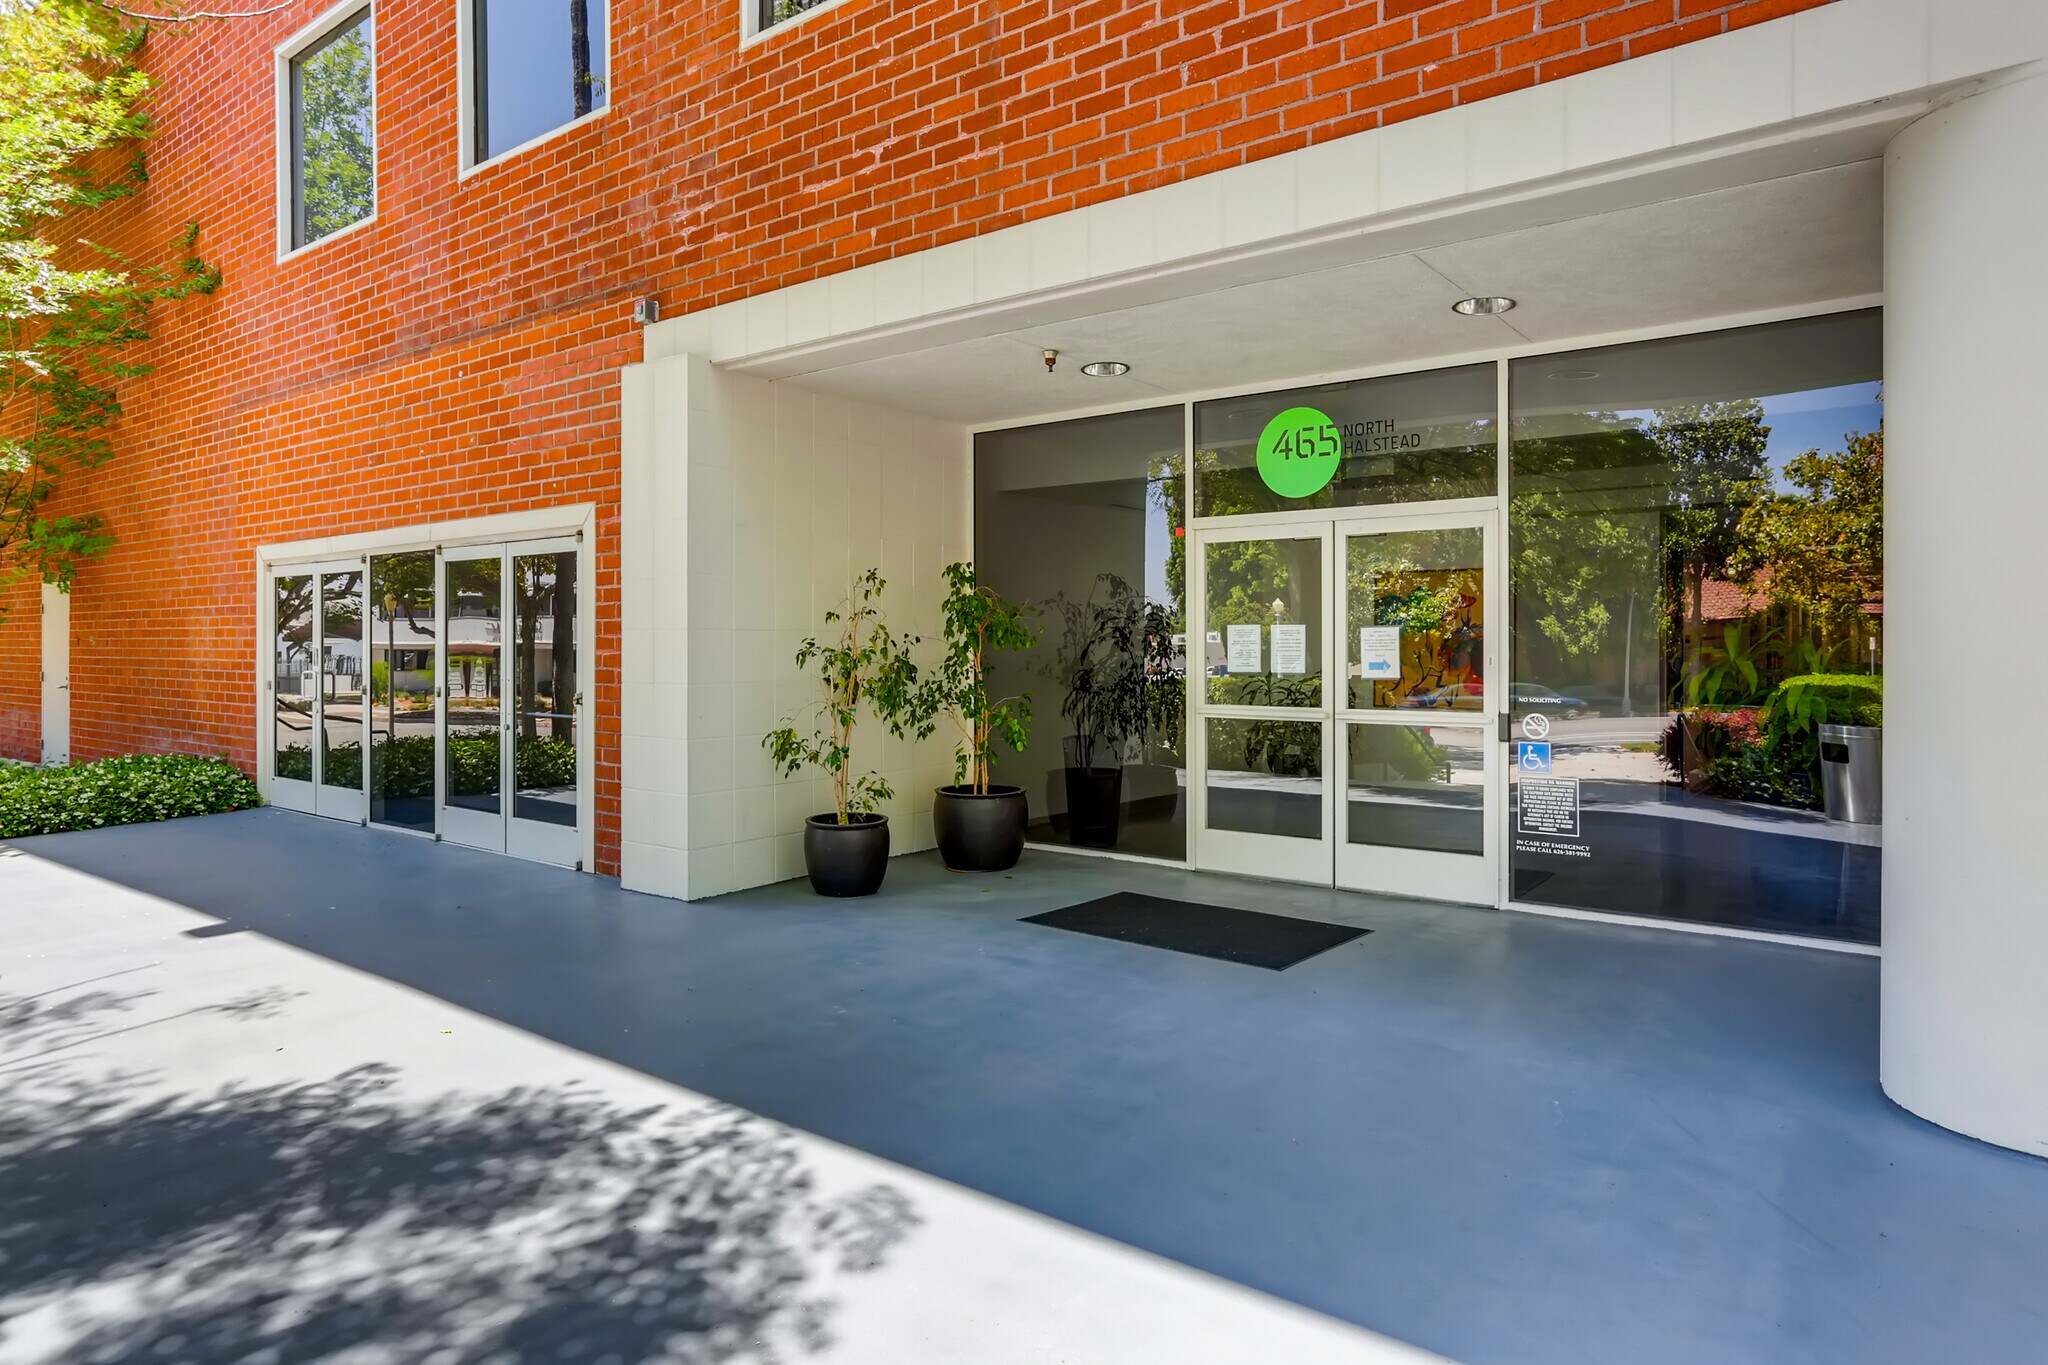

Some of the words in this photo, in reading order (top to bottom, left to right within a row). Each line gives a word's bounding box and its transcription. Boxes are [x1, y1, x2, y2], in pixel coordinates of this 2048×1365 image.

[1344, 419, 1395, 438] NORTH
[1272, 425, 1338, 460] 465
[1344, 433, 1421, 455] HALSTEAD
[1551, 842, 1590, 851] EMERGENCY
